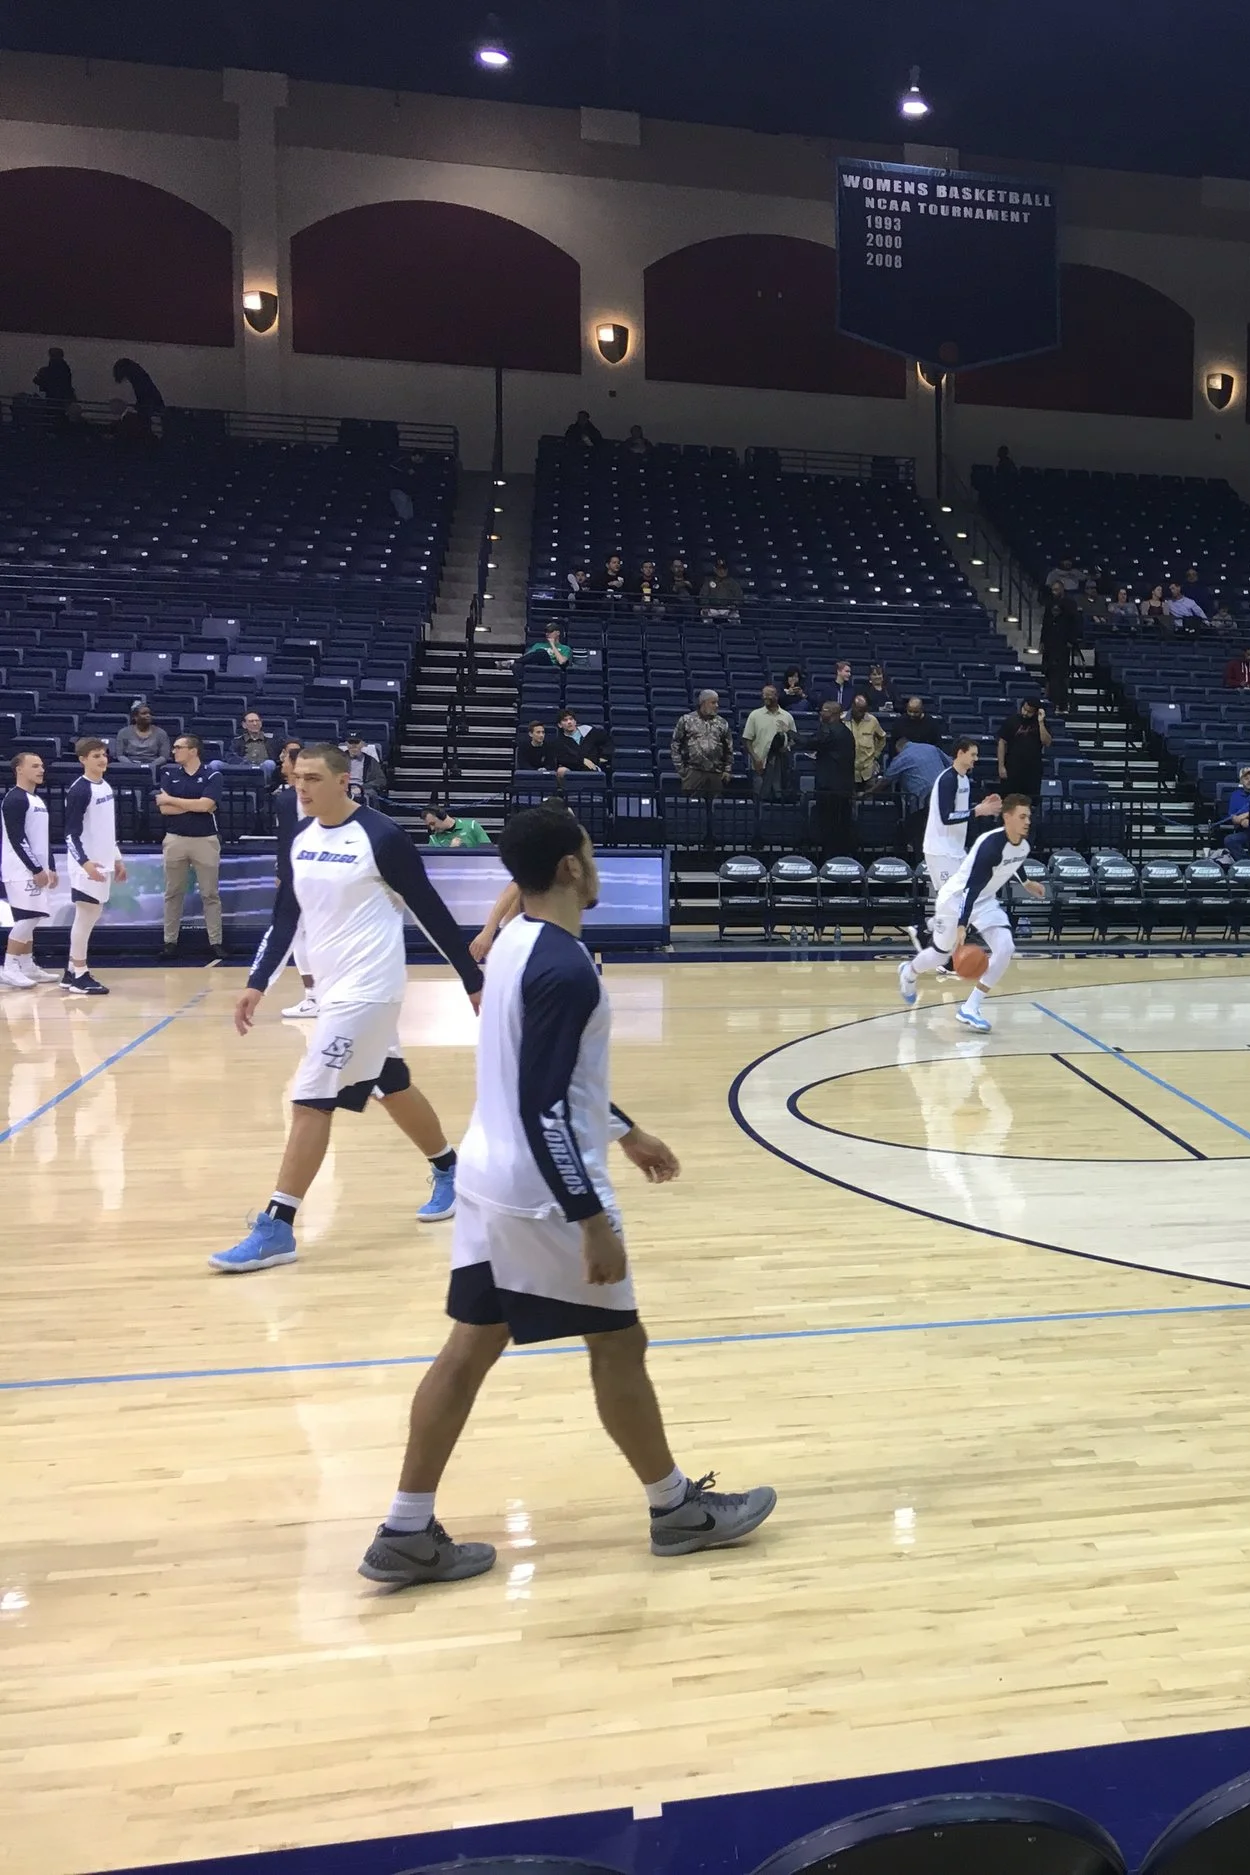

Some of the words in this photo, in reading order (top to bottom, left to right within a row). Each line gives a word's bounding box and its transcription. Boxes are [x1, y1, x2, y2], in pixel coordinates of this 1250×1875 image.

[842, 174, 929, 196] WOMENS
[936, 184, 1051, 207] BASKETBALL
[865, 197, 911, 213] NCAA
[918, 202, 1031, 224] TOURNAMENT
[866, 214, 901, 232] 1993
[866, 233, 902, 249] 2000
[866, 253, 902, 269] 2008
[539, 1100, 589, 1196] TOREROS
